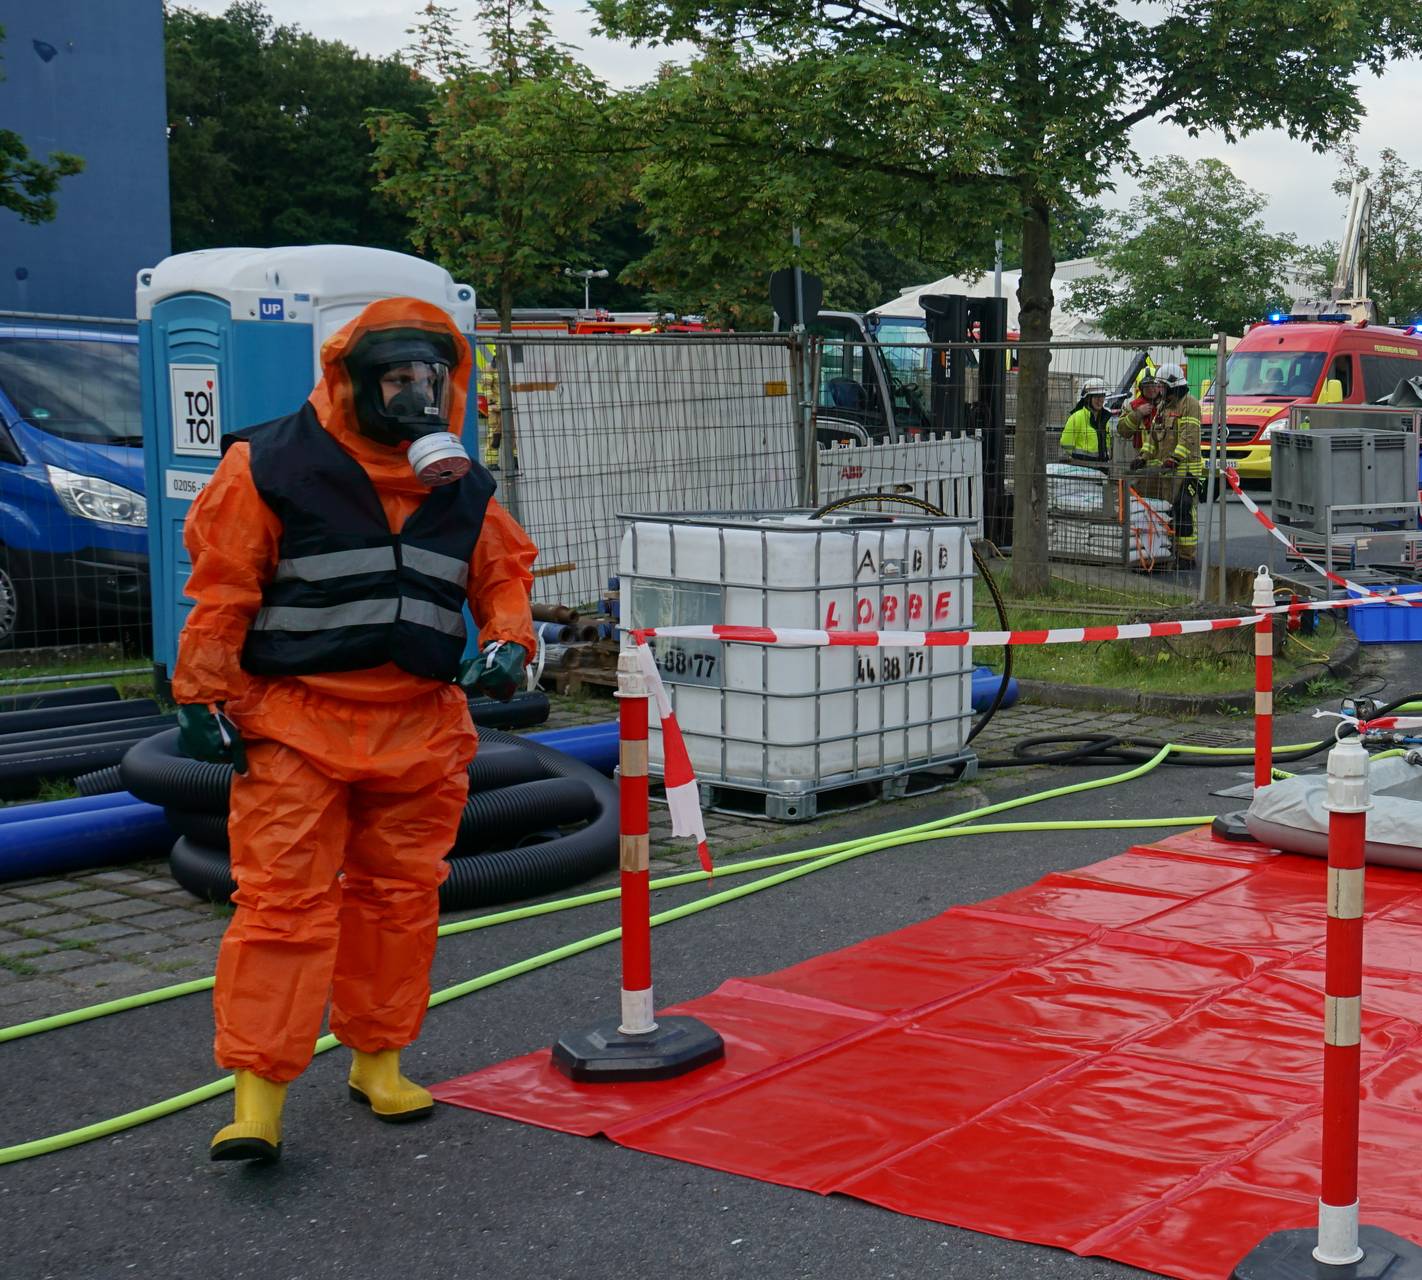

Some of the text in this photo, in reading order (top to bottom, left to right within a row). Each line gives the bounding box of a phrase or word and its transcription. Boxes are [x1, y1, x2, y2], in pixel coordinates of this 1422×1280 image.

[262, 303, 281, 315] UP
[186, 418, 215, 444] TOI
[825, 591, 951, 629] LOBBE
